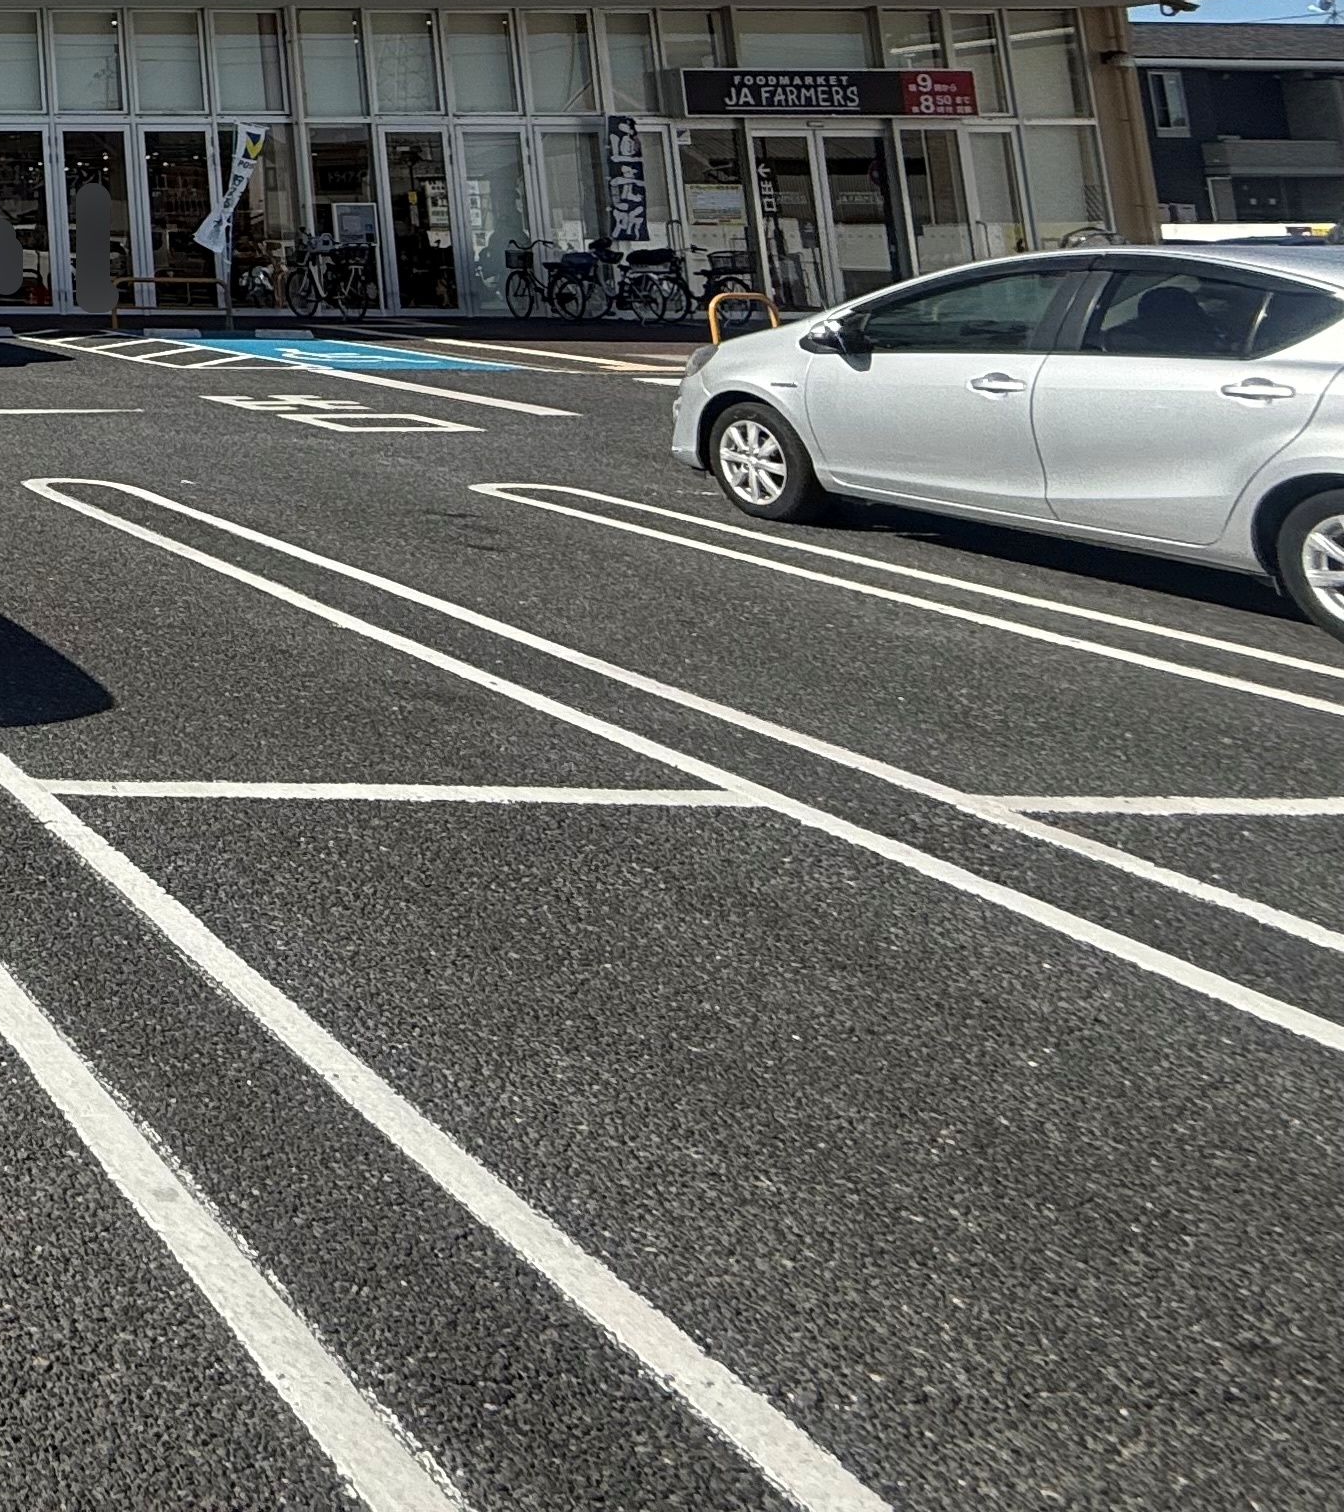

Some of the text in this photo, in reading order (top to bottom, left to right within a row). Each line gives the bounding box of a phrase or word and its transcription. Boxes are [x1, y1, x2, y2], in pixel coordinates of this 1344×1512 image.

[733, 75, 849, 85] FOODMARKET
[724, 86, 859, 106] JA FARMERS
